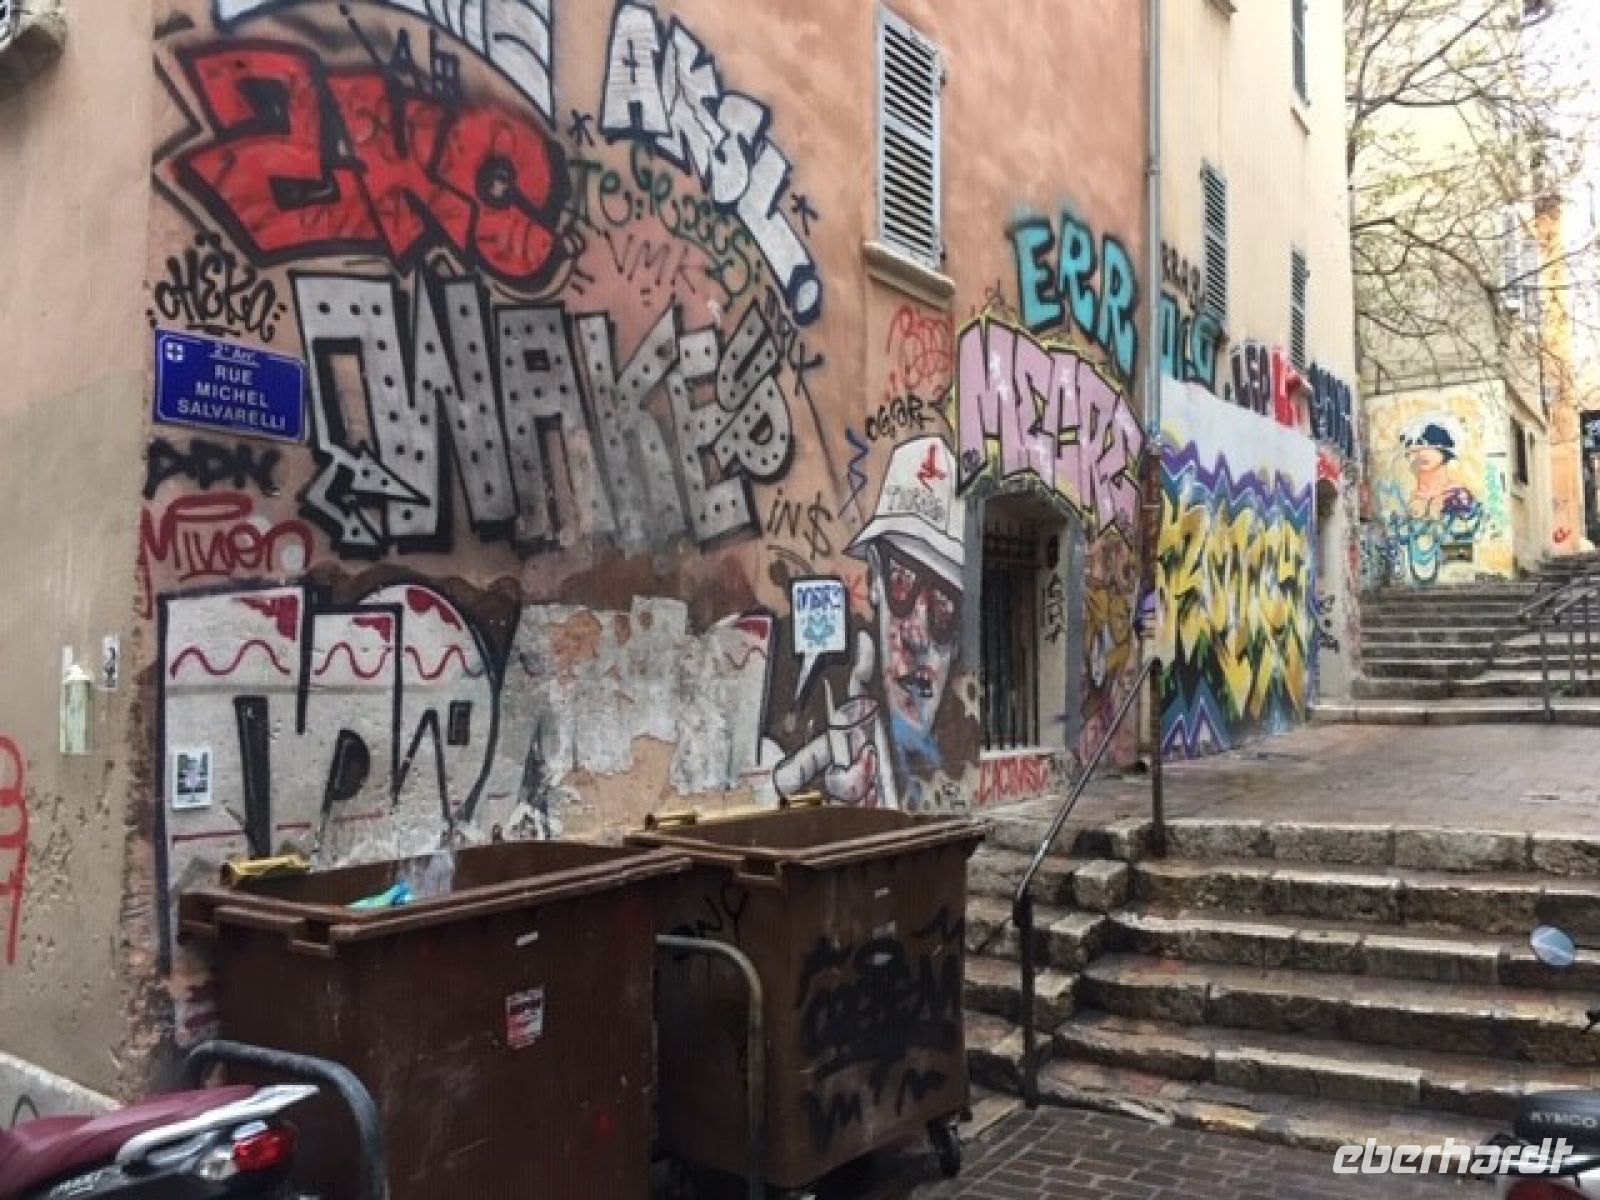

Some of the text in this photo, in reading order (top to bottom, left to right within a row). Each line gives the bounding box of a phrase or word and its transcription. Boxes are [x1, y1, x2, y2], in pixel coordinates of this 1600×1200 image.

[214, 364, 254, 386] RUE
[194, 382, 269, 409] MICHEL
[177, 396, 286, 431] SALVARELLI
